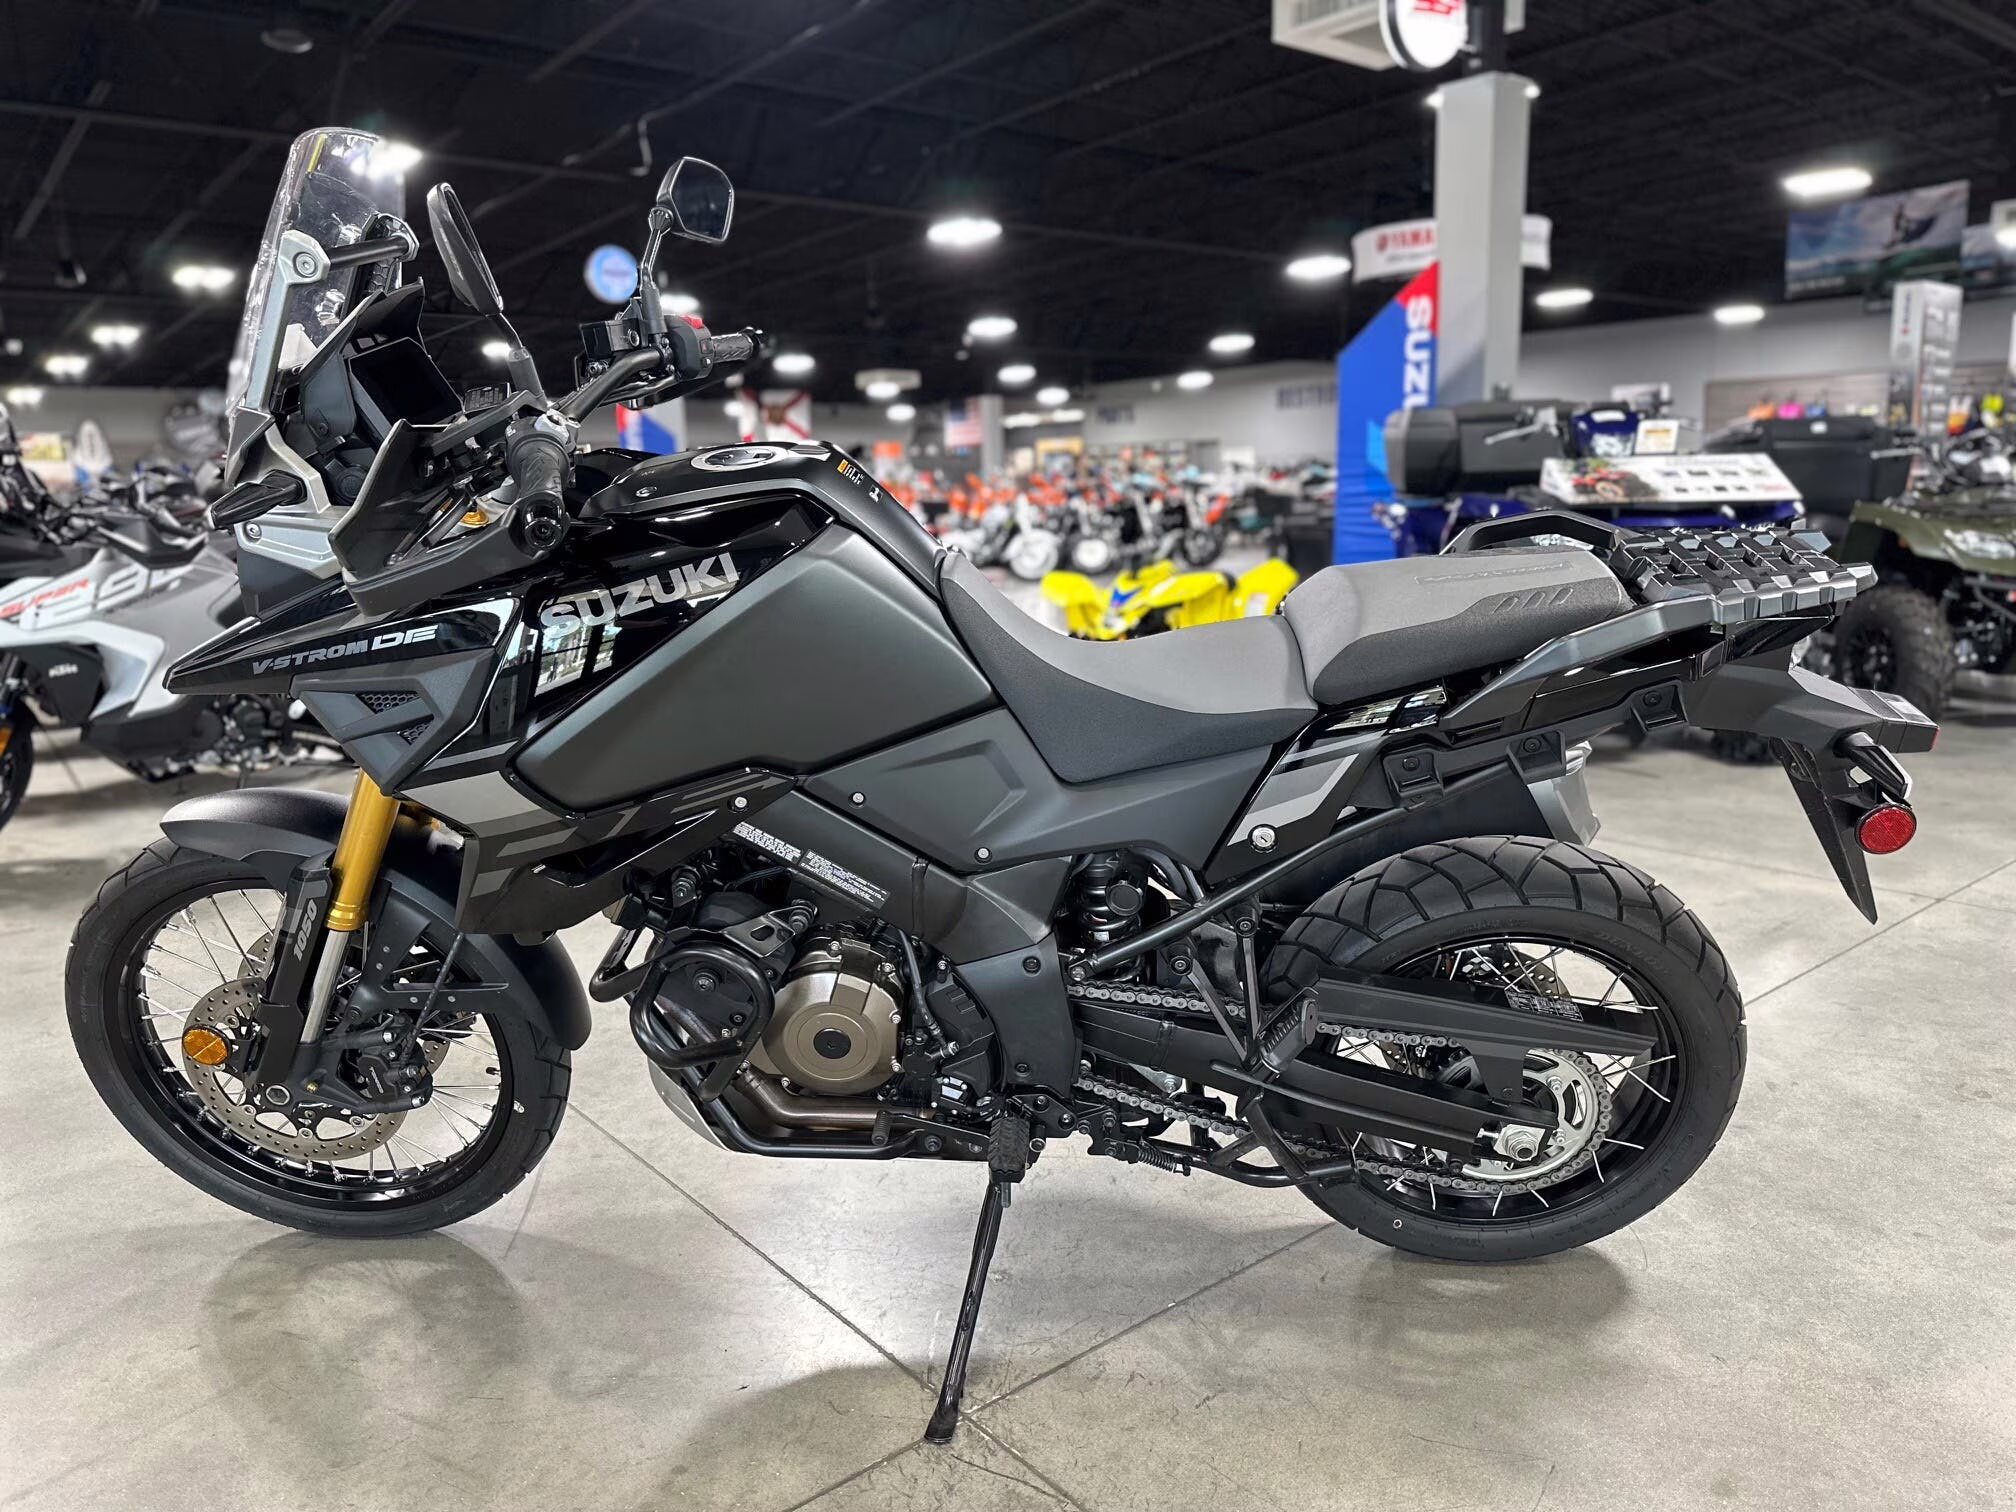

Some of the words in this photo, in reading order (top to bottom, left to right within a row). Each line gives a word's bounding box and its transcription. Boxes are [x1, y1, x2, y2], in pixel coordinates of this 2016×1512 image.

[540, 552, 739, 638] SUZUKI
[252, 640, 368, 675] V-STROM
[371, 624, 439, 651] DE
[293, 899, 318, 961] 1050
